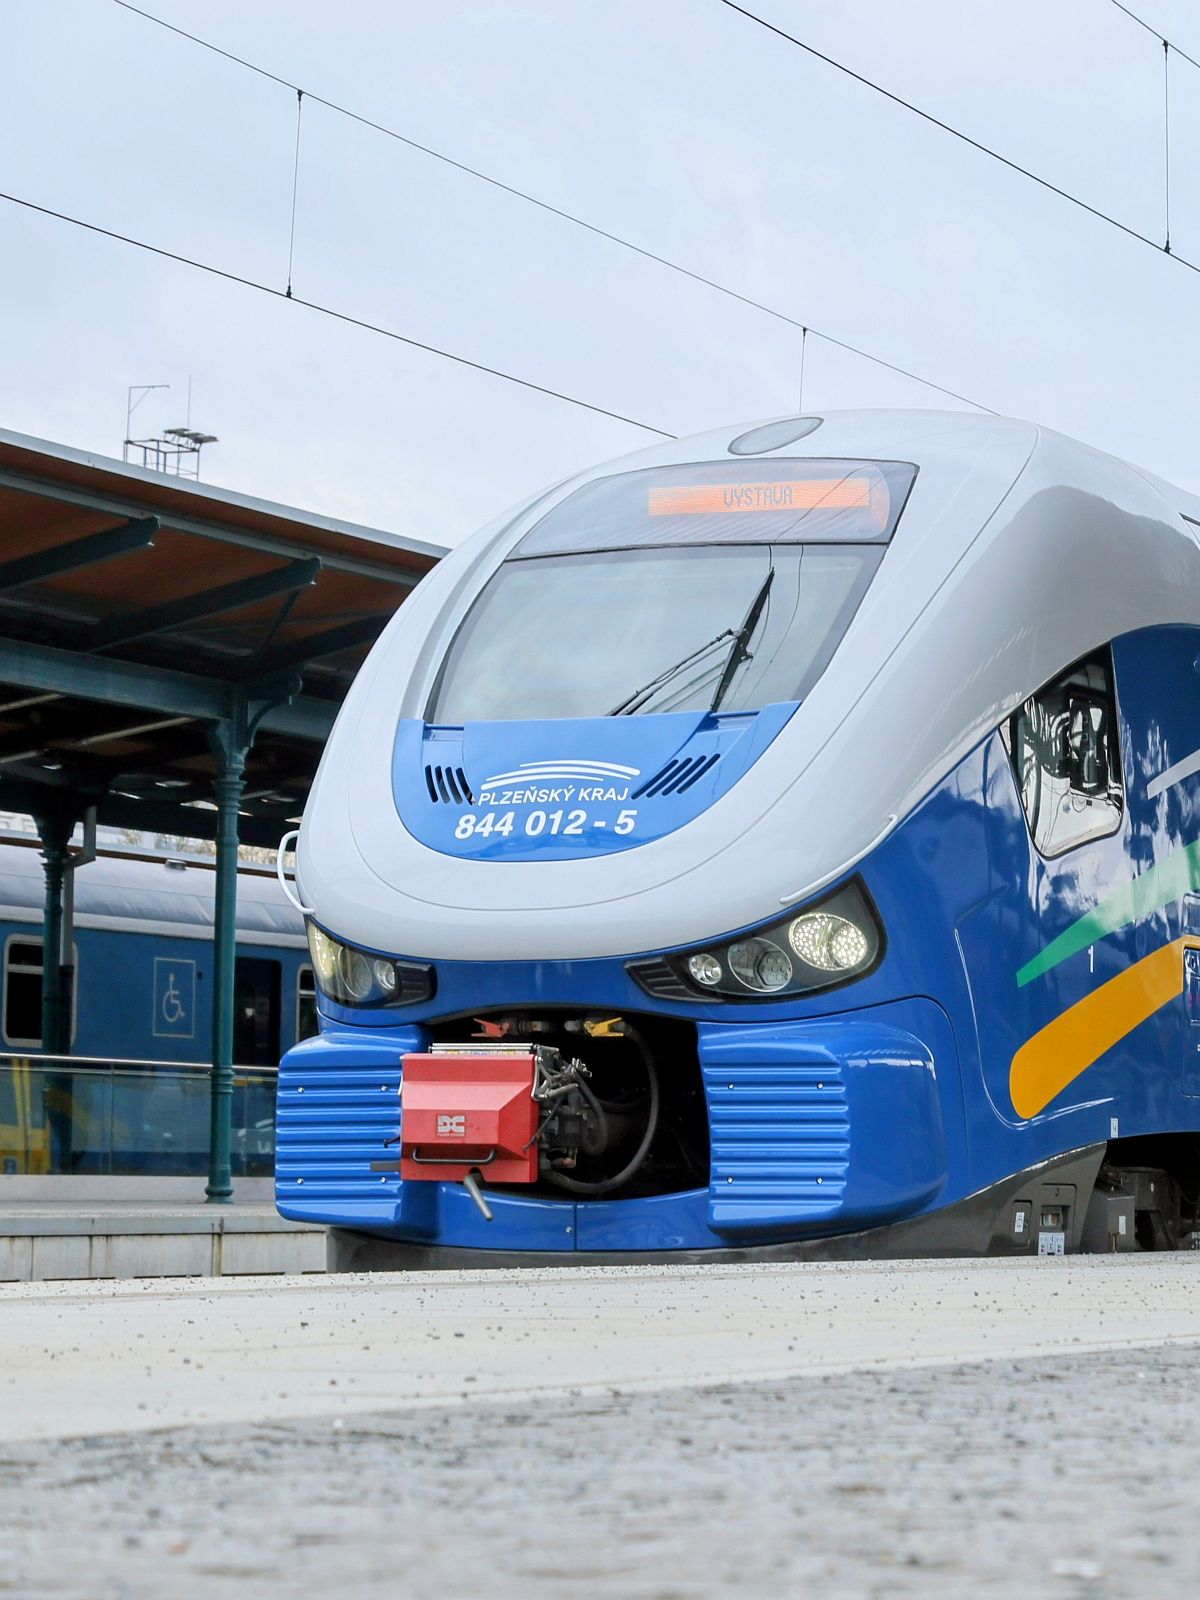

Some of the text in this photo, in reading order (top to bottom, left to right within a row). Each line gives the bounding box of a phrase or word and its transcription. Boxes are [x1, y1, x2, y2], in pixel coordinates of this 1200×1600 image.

[478, 785, 629, 806] PLZEŇSKÝ KRAJ
[454, 811, 515, 840] 844
[1087, 945, 1094, 973] 1
